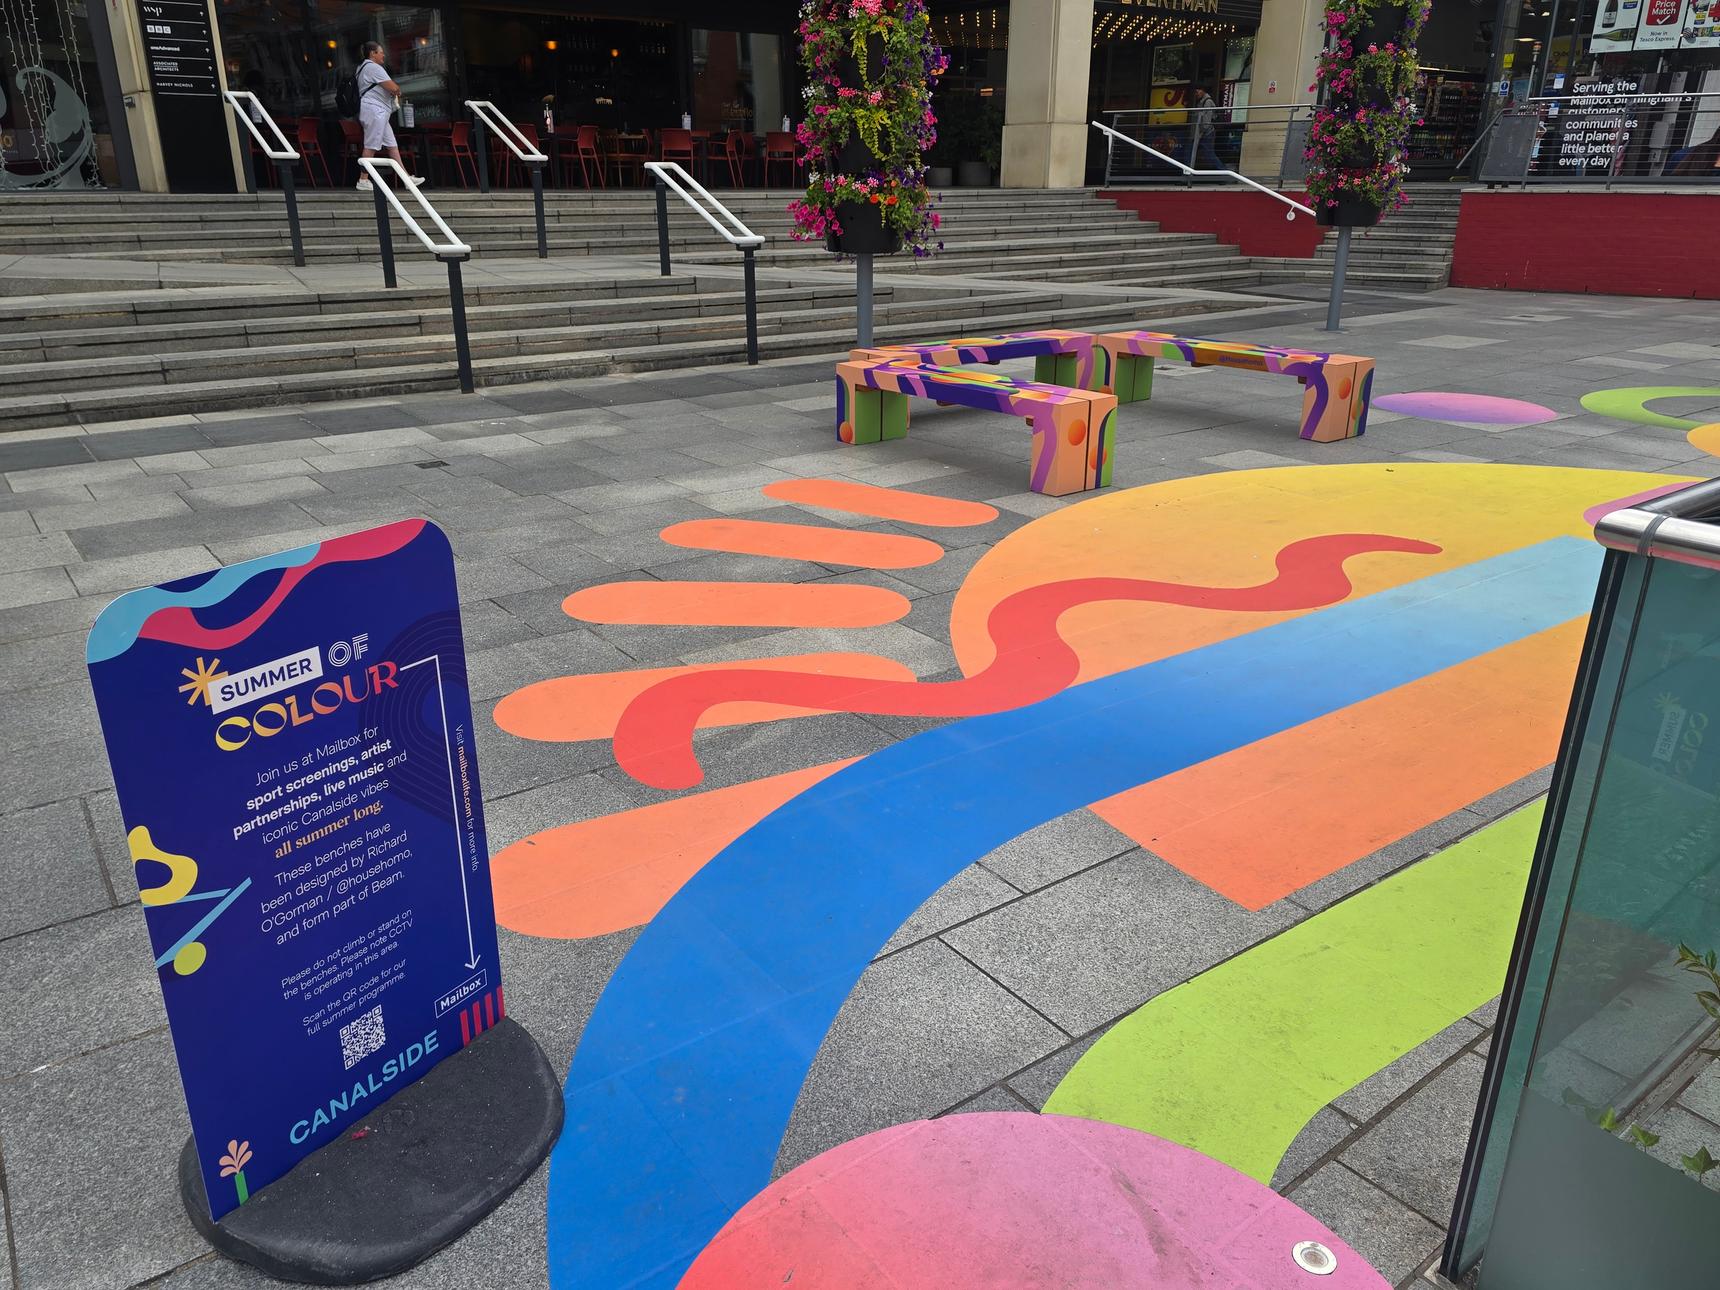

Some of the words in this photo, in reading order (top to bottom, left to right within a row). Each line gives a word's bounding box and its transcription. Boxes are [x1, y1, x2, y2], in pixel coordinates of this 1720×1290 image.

[146, 25, 171, 34] BBC
[1655, 0, 1676, 8] Price
[1570, 94, 1611, 106] Mailbox
[1572, 82, 1614, 94] Serving
[1617, 81, 1637, 91] the
[1561, 143, 1586, 153] little
[1563, 131, 1583, 141] and
[1622, 132, 1630, 140] a
[1565, 118, 1638, 129] communites
[1558, 157, 1589, 168] every
[1590, 156, 1611, 167] day
[220, 657, 313, 702] SUMMER
[328, 633, 369, 667] OF
[215, 660, 399, 752] COLOUR
[455, 723, 465, 745] Visit
[246, 786, 284, 811] sport
[285, 755, 359, 793] screenings,
[361, 739, 392, 761] artist
[255, 767, 280, 787] Join
[283, 760, 298, 774] us
[301, 752, 314, 767] at
[316, 733, 361, 761] Mailbox
[363, 725, 379, 740] for
[457, 747, 472, 818] mailboxlife.com
[232, 791, 322, 840] partnerships,
[323, 780, 346, 797] live
[348, 762, 385, 786] music
[387, 750, 407, 768] and
[262, 820, 298, 845] iconic
[301, 792, 358, 826] Canalside
[360, 779, 390, 798] vibes
[466, 818, 475, 830] for
[274, 862, 312, 886] These
[315, 836, 364, 867] benches
[365, 822, 391, 842] have
[275, 840, 293, 859] all
[295, 813, 350, 849] summer
[353, 799, 384, 821] long.
[467, 830, 477, 854] more
[260, 890, 292, 914] been
[295, 861, 348, 896] designed
[351, 853, 364, 868] by
[367, 830, 408, 860] Richard
[261, 894, 323, 933] O'Gorman
[326, 885, 333, 901] /
[336, 849, 413, 895] @househomo,
[470, 854, 480, 872] info
[276, 924, 300, 945] and
[302, 909, 331, 931] form
[333, 893, 357, 917] part
[358, 885, 370, 901] of
[371, 870, 406, 894] Beam.
[281, 969, 312, 989] Please
[313, 958, 326, 970] do
[327, 949, 341, 964] not
[342, 936, 366, 955] climb
[367, 928, 377, 940] or
[377, 916, 400, 934] stand
[400, 909, 412, 921] on
[283, 986, 299, 1000] the
[299, 966, 339, 992] benches.
[340, 946, 368, 969] Please
[369, 936, 388, 953] note
[388, 918, 414, 939] CCTV
[304, 992, 312, 1001] is
[313, 967, 353, 998] operating
[354, 960, 363, 971] in
[364, 952, 379, 969] this
[380, 941, 400, 957] area.
[302, 1010, 326, 1026] Scan
[327, 998, 341, 1013] the
[342, 986, 357, 1002] QR
[358, 975, 379, 993] code
[380, 964, 393, 980] for
[393, 958, 407, 972] our
[306, 1021, 320, 1037] full
[321, 1002, 357, 1031] summer
[358, 972, 406, 1010] programme.
[440, 978, 482, 1011] Mailbox
[289, 1029, 440, 1145] CANALSIDE
